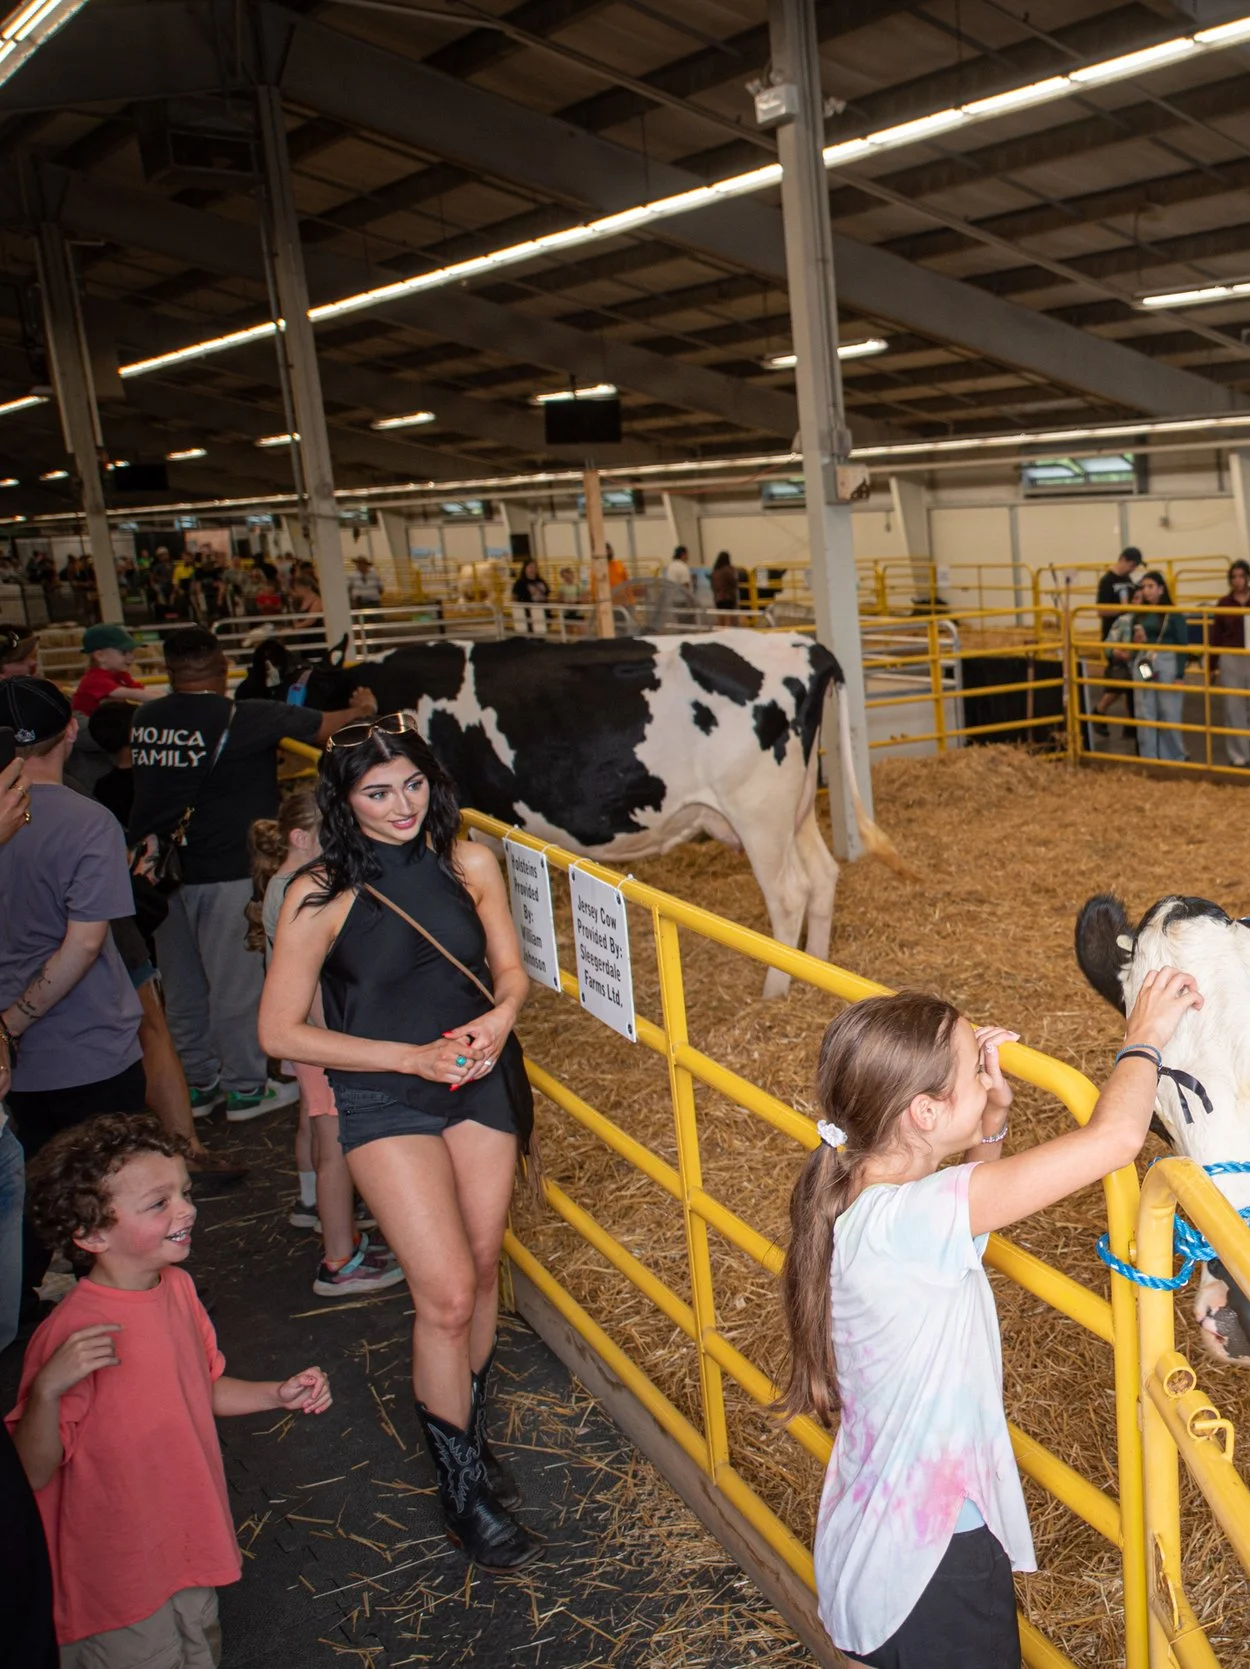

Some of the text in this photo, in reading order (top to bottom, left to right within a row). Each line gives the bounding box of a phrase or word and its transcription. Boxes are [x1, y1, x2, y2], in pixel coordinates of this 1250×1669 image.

[131, 726, 206, 747] MOJICA
[131, 749, 207, 768] FAMILY
[514, 877, 539, 902] Provided
[523, 903, 534, 924] By:
[577, 895, 617, 930] Jersey Cow
[577, 918, 623, 960] Provided By:
[580, 943, 622, 982] Sleegerdale
[584, 969, 623, 1008] Farms Ltd.
